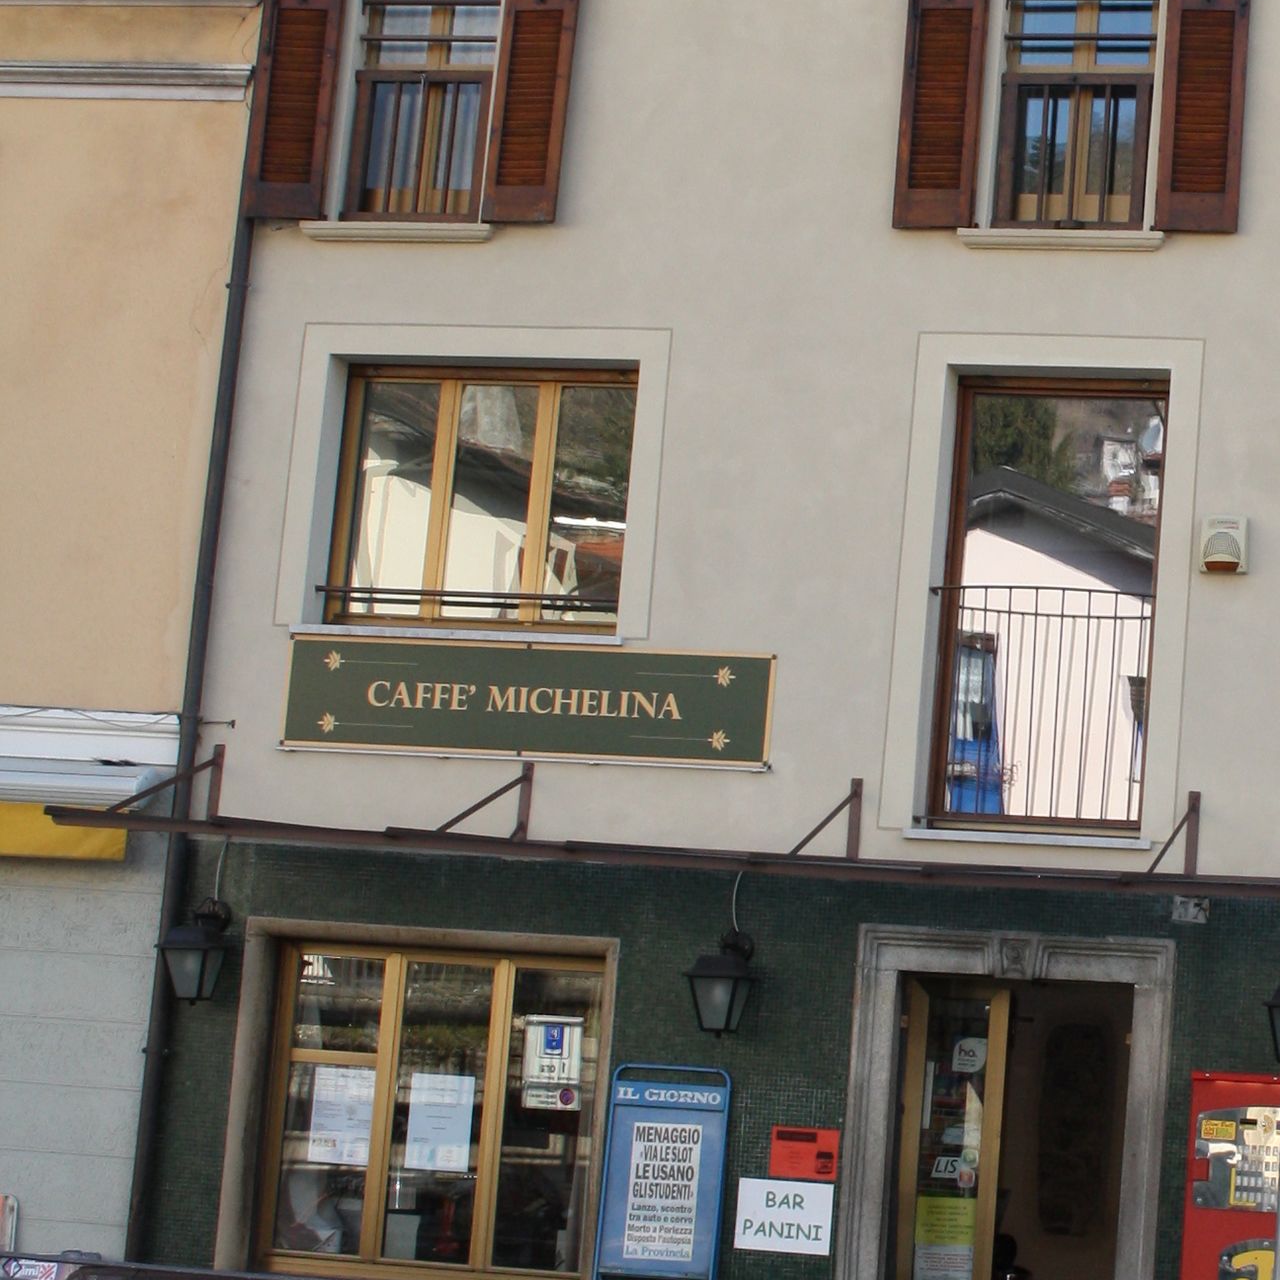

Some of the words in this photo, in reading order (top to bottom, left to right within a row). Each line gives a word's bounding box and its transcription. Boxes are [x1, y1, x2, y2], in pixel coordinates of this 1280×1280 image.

[366, 680, 477, 711] CAFFE'
[486, 685, 683, 721] MICHELINA
[617, 1087, 640, 1100] IL
[644, 1088, 722, 1105] GIORNO
[634, 1126, 701, 1145] MENAGGIO
[660, 1146, 671, 1162] LE
[672, 1146, 693, 1163] SLOT
[635, 1163, 652, 1180] LE
[652, 1164, 695, 1182] USANO
[934, 1159, 959, 1174] LIS
[632, 1182, 648, 1199] GLI
[660, 1204, 693, 1214] scontro
[765, 1190, 805, 1211] BAR
[629, 1213, 641, 1222] tra
[642, 1213, 662, 1222] auto
[627, 1223, 651, 1233] Morto
[742, 1218, 824, 1242] PANINI
[624, 1245, 638, 1256] La
[640, 1245, 690, 1259] Provincia
